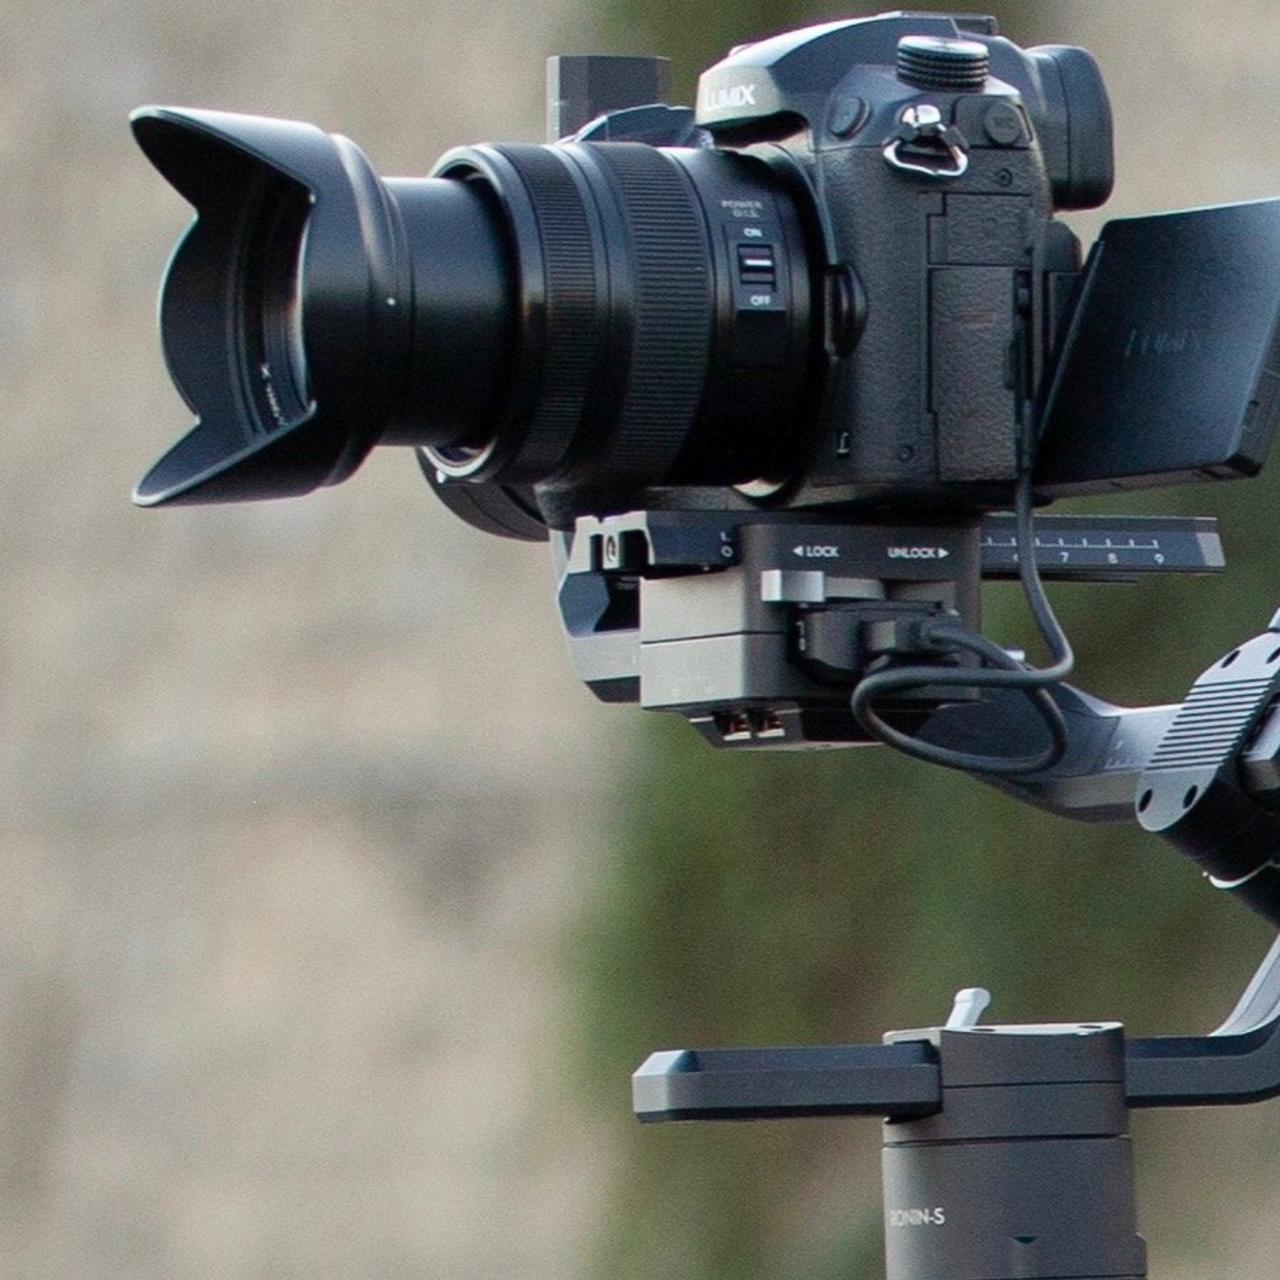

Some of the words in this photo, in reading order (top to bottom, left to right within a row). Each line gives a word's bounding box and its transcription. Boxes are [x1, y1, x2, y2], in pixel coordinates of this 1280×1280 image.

[743, 227, 763, 237] ON
[750, 295, 771, 306] OFF
[806, 547, 839, 558] LOCK
[888, 547, 938, 559] UNLOCK
[1061, 552, 1070, 563] 7
[1154, 553, 1165, 565] 9
